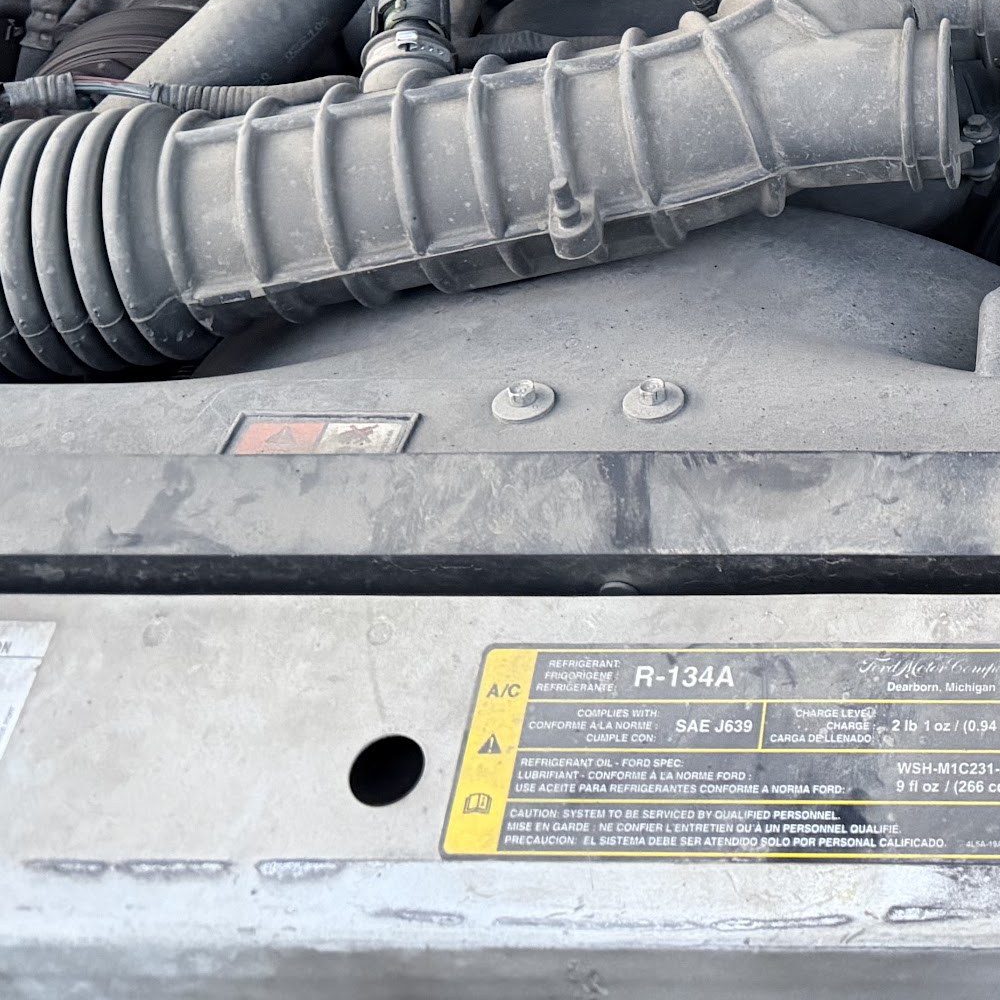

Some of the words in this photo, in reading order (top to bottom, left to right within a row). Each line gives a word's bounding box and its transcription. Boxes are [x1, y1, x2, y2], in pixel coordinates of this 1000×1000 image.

[548, 659, 621, 668] REFRIGERANT:
[859, 657, 900, 674] Ford
[893, 657, 947, 678] Motor
[634, 665, 734, 688] R-134A
[486, 683, 522, 698] A/C
[535, 683, 617, 692] REFRIGERANTE:
[945, 682, 996, 694] Michigan
[577, 708, 629, 718] COMPLIES
[632, 709, 660, 718] WITH:
[795, 709, 839, 718] CHARGE
[528, 721, 587, 730] CONFORME
[615, 721, 652, 730] NORME
[675, 719, 713, 733] SAE
[714, 719, 753, 733] J639
[826, 721, 870, 731] CHARGE
[892, 719, 900, 732] 2
[904, 719, 918, 732] lb
[924, 720, 930, 732] 1
[934, 722, 950, 732] oz
[963, 719, 997, 735] (0.94
[586, 733, 628, 742] CUMPLE
[631, 734, 657, 742] CON:
[769, 733, 806, 743] CARGA
[808, 733, 824, 743] DE
[520, 757, 596, 768] REFRIGERANT
[597, 758, 613, 768] OIL
[622, 758, 650, 768] FORD
[653, 758, 684, 768] SPEC:
[517, 770, 580, 780] LUBRIFIANT
[588, 771, 647, 780] CONFORME
[676, 771, 714, 780] NORME
[716, 771, 746, 780] FORD
[515, 783, 536, 792] USE
[538, 783, 576, 792] ACEITE
[579, 783, 607, 793] PARA
[609, 784, 697, 793] REFRIGERANTES
[700, 784, 760, 794] CONFORME
[761, 785, 770, 794] A
[771, 785, 810, 794] NORMA
[812, 785, 846, 794] FORD:
[896, 780, 904, 793] 9
[909, 780, 918, 793] fl
[922, 783, 940, 793] oz
[953, 780, 984, 795] (266
[562, 809, 606, 819] SYSTEM
[608, 809, 622, 819] TO
[625, 809, 639, 819] BE
[642, 809, 695, 819] SERVICED
[698, 810, 712, 819] BY
[714, 810, 771, 820] QUALIFIED
[773, 810, 841, 820] PERSONNEL.
[506, 822, 532, 831] MISE
[535, 822, 550, 831] EN
[552, 822, 590, 832] GARDE
[599, 822, 614, 832] NE
[616, 823, 663, 832] CONFIER
[665, 823, 733, 833] L'ENTRETIEN
[764, 823, 780, 833] UN
[783, 824, 848, 834] PERSONNEL
[583, 836, 597, 845] EL
[600, 836, 646, 846] SISTEMA
[648, 836, 677, 846] DEBE
[680, 837, 702, 846] SER
[704, 837, 758, 847] ATENDIDO
[761, 837, 790, 847] SOLO
[793, 837, 816, 847] POR
[818, 838, 876, 848] PERSONAL
[879, 838, 947, 848] CALIFICADO.
